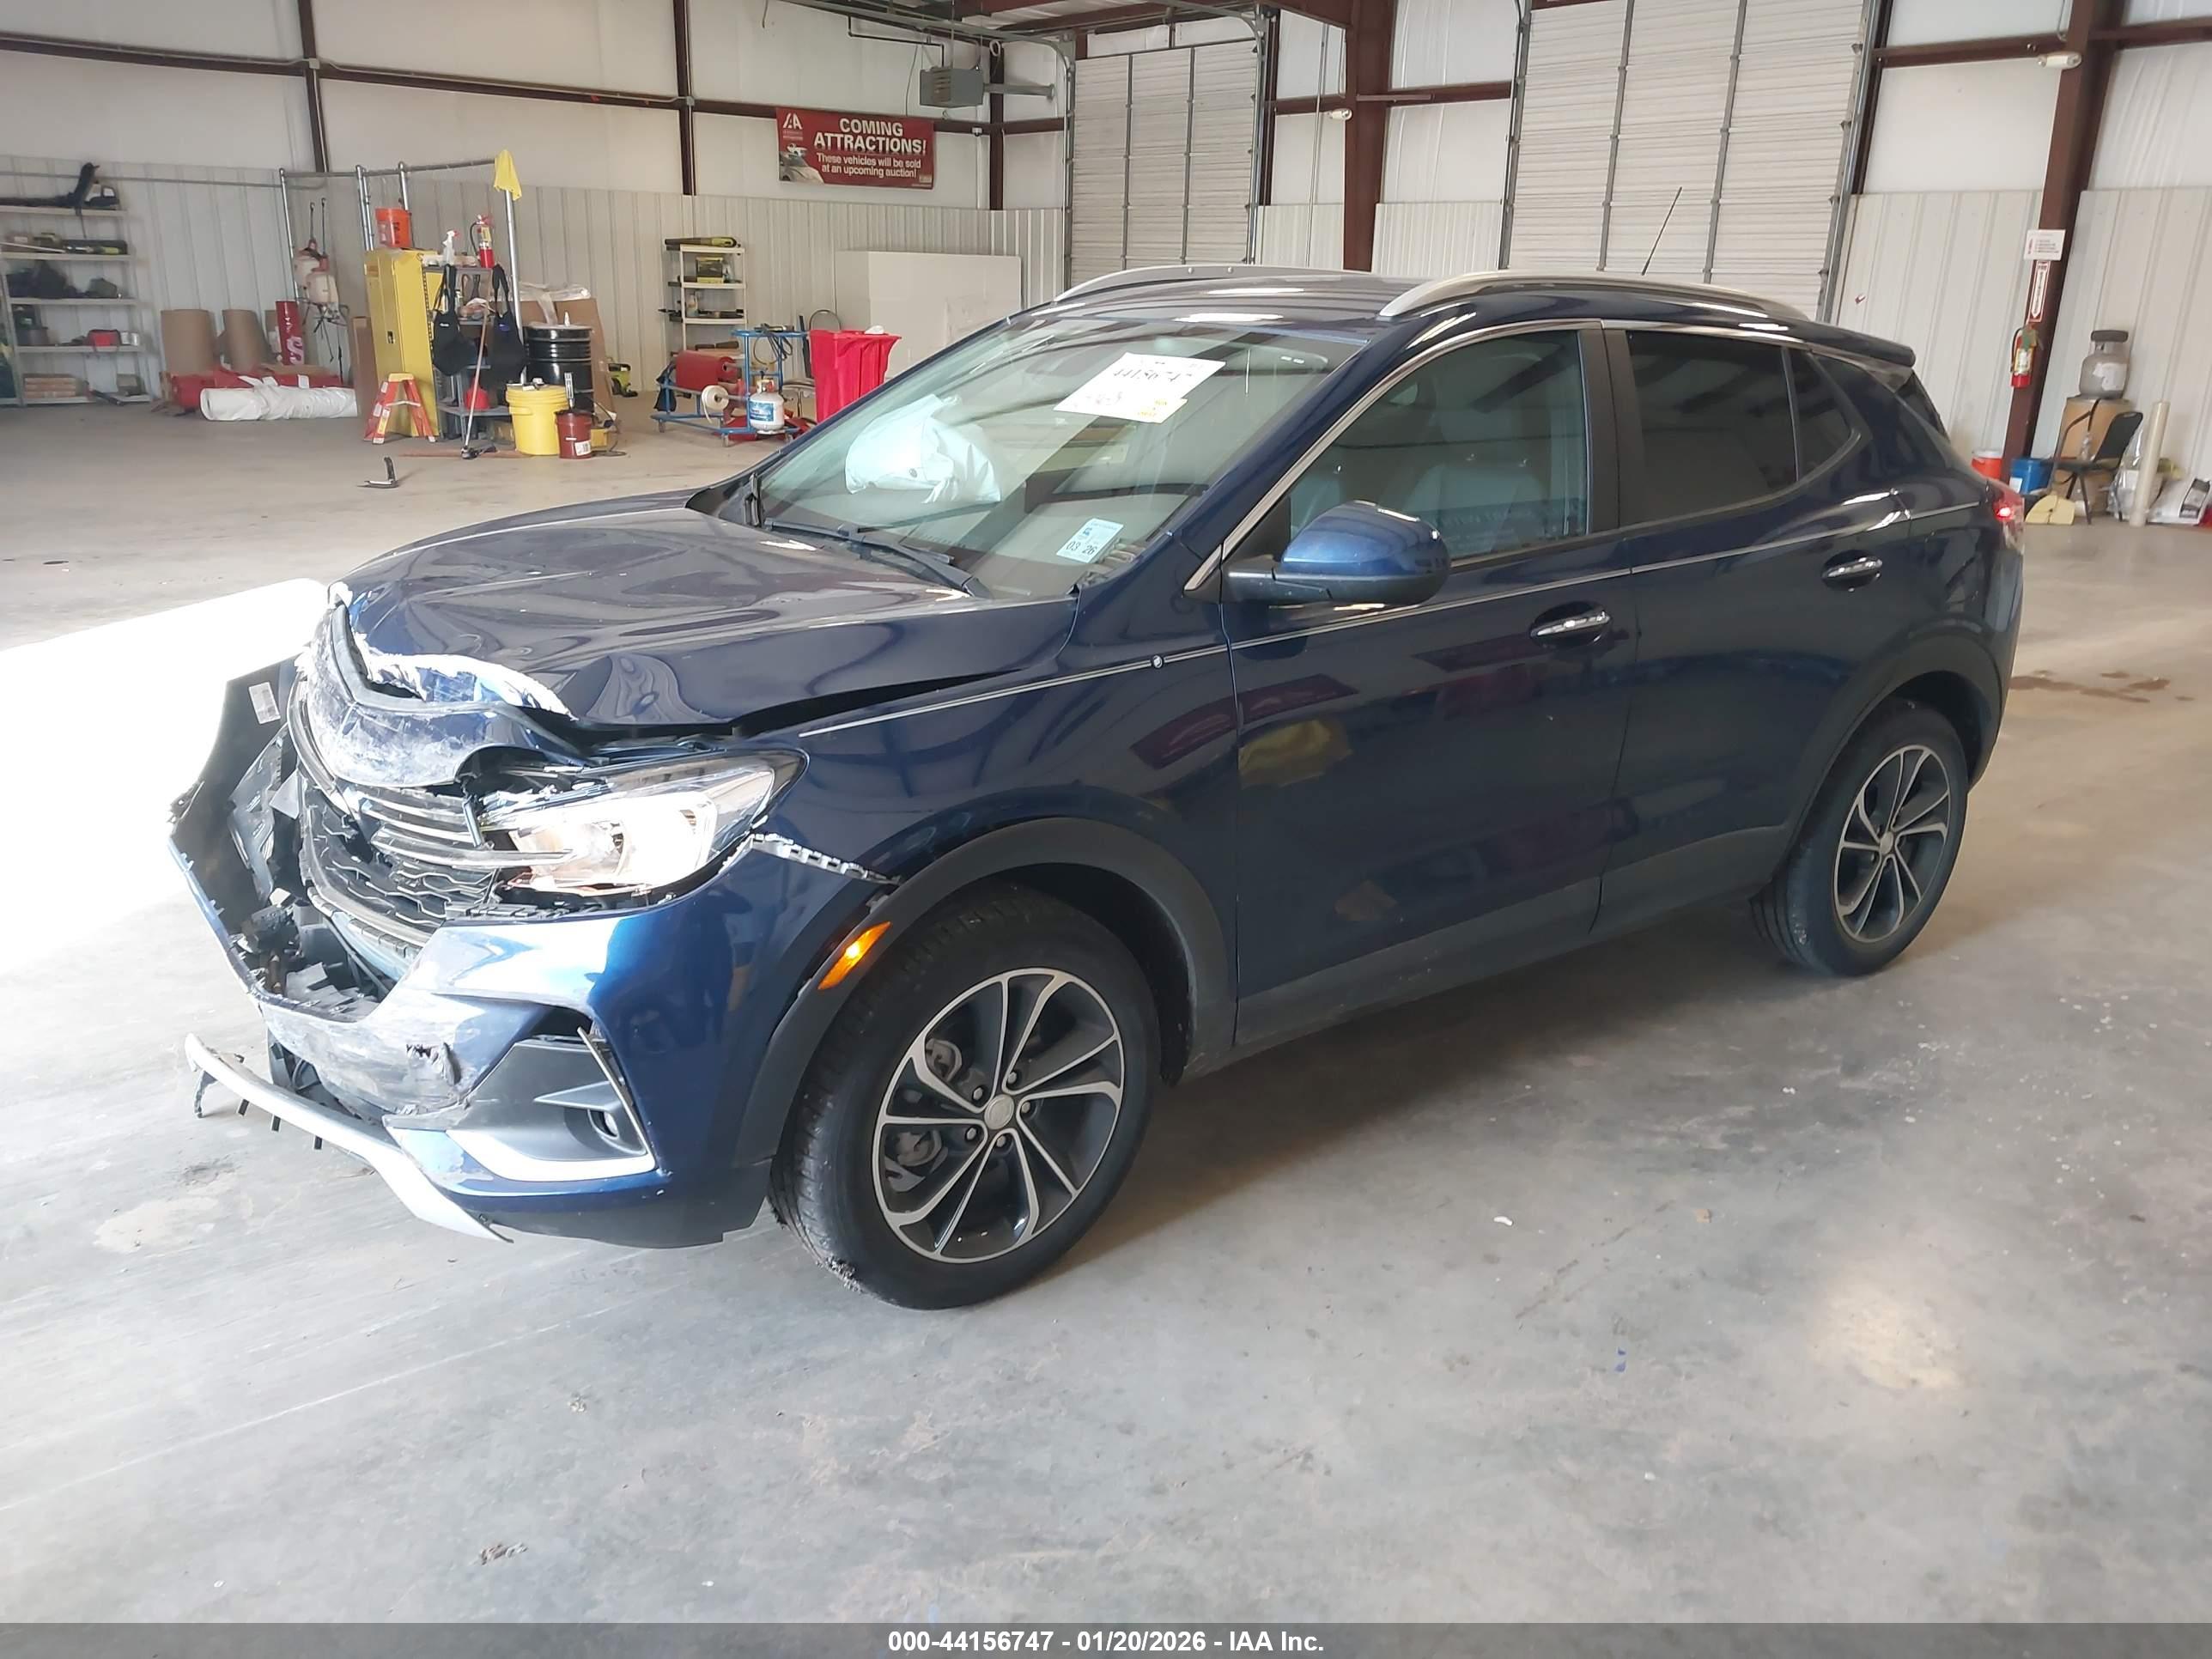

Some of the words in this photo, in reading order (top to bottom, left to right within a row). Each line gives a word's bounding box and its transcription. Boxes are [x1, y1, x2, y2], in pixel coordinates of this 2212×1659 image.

[839, 118, 903, 137] COMING
[814, 132, 927, 153] ATTRACTIONS!
[817, 153, 842, 163] These
[843, 155, 877, 167] vehicles
[878, 157, 891, 167] will
[893, 158, 903, 168] be
[905, 159, 921, 168] sold
[822, 164, 830, 173] at
[831, 165, 842, 173] an
[843, 166, 884, 179] upcoming
[885, 168, 917, 178] auction!
[1082, 544, 1097, 556] 26
